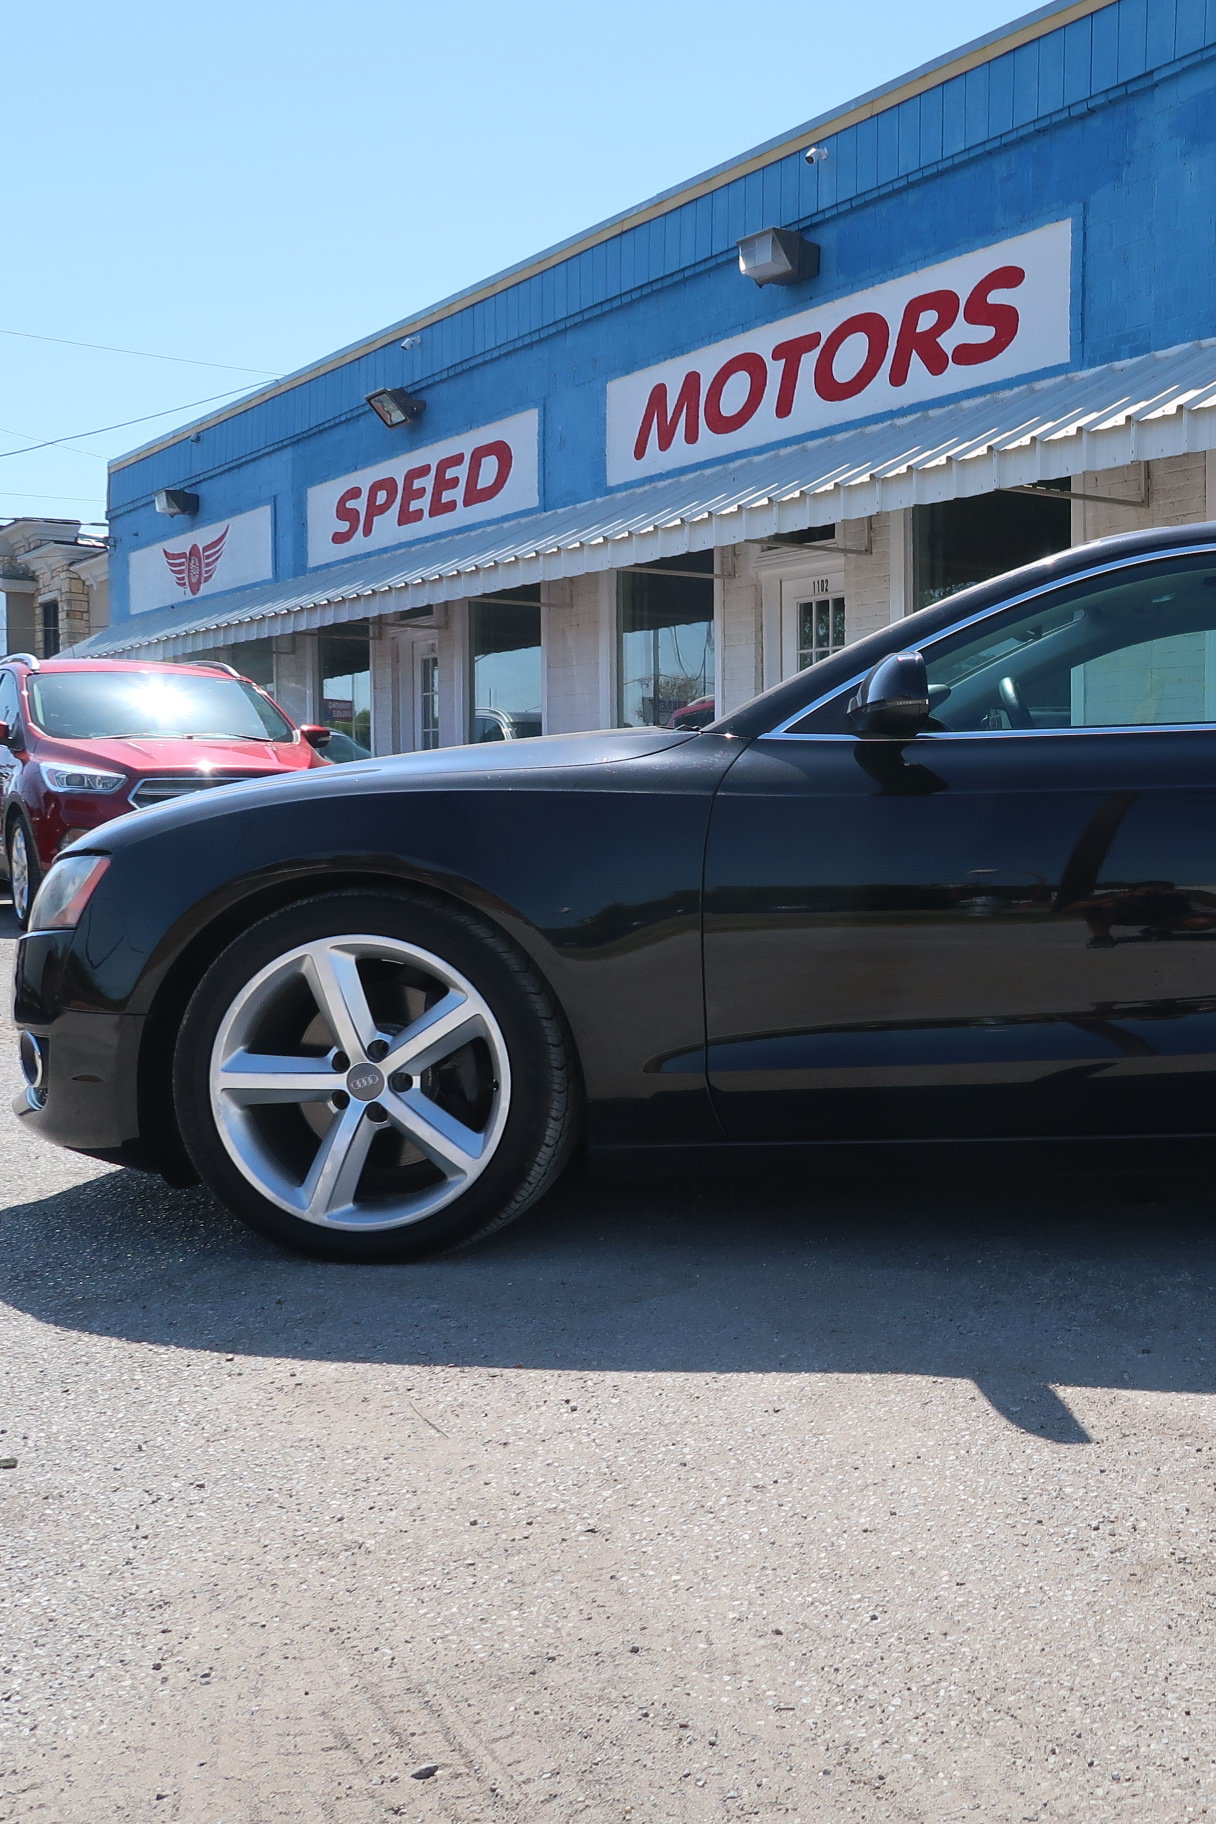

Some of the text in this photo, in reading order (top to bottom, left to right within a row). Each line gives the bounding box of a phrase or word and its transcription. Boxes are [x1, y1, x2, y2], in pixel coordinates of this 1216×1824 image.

[634, 265, 1026, 460] MOTORS
[331, 439, 513, 546] SPEED
[812, 578, 829, 594] 1102
